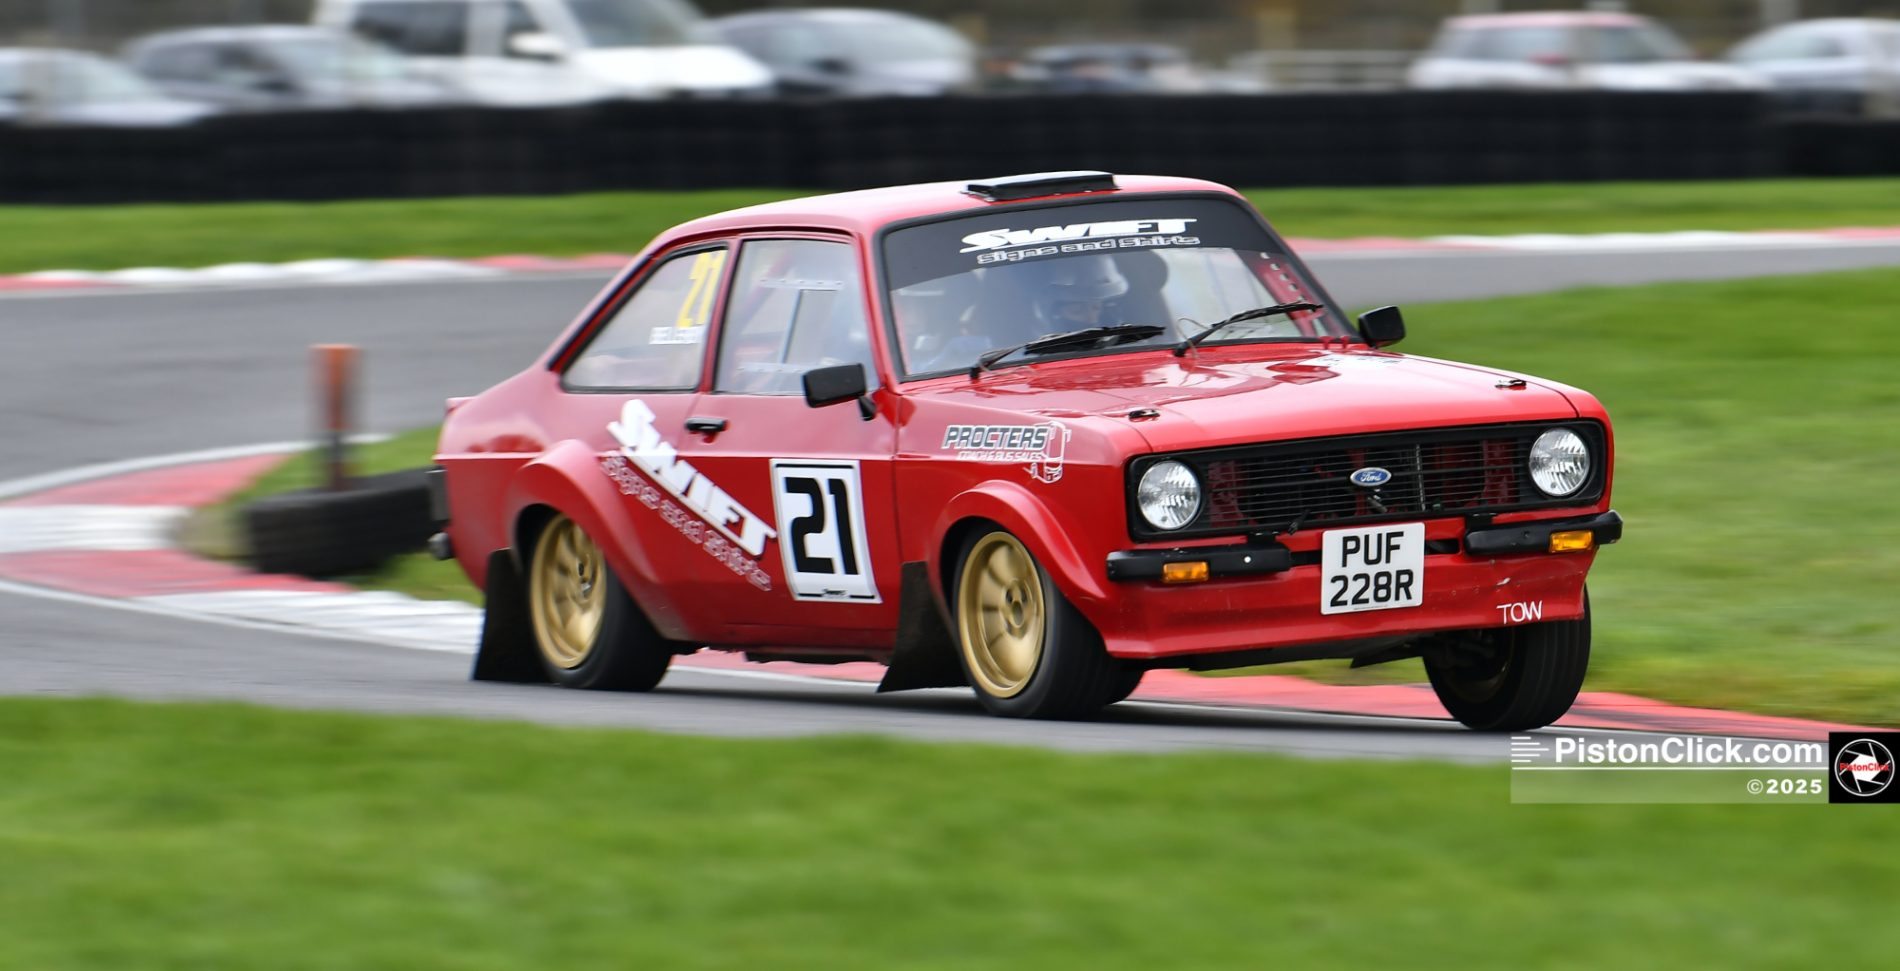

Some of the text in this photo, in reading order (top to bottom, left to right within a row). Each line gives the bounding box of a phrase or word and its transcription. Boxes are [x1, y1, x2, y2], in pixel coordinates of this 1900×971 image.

[960, 218, 1198, 254] SWIFT
[977, 235, 1200, 265] Signs and Shirts
[676, 250, 726, 328] 21
[941, 424, 1050, 451] PROCTERS
[606, 399, 777, 556] SWIFT
[1360, 471, 1382, 482] Ford
[784, 476, 859, 575] 21
[1342, 531, 1404, 567] PUF
[1330, 569, 1414, 607] 228R
[1496, 600, 1543, 625] TOW
